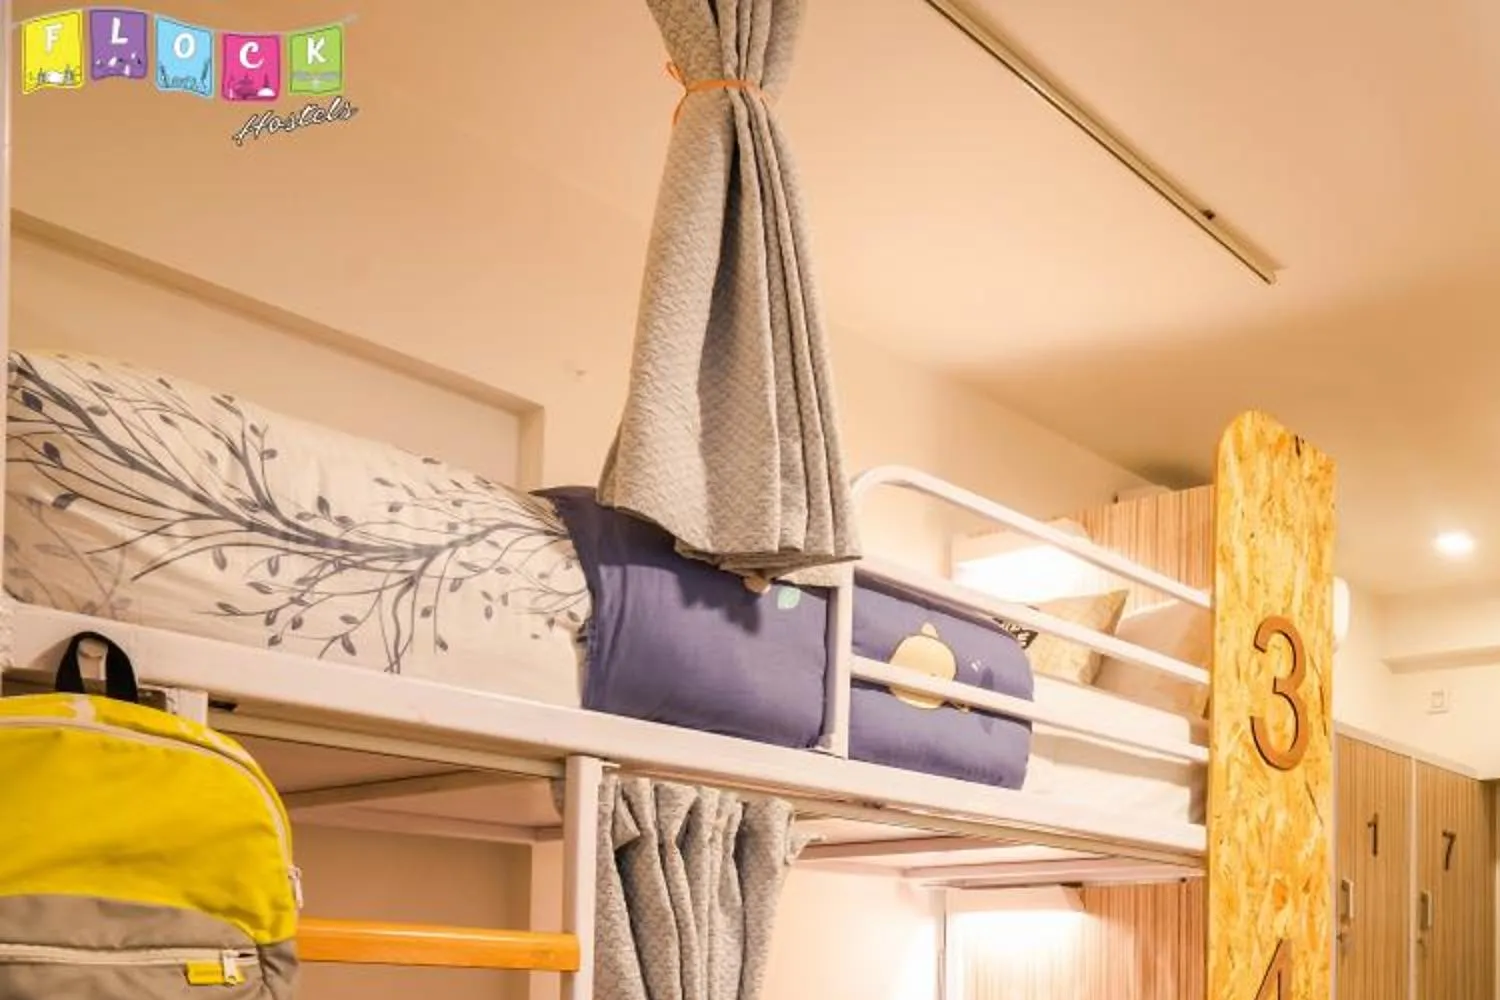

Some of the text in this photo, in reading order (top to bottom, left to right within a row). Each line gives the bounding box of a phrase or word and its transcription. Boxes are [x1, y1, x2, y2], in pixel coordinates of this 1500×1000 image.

[1250, 615, 1309, 772] 3
[1367, 812, 1378, 857] 1
[1442, 830, 1456, 872] 7
